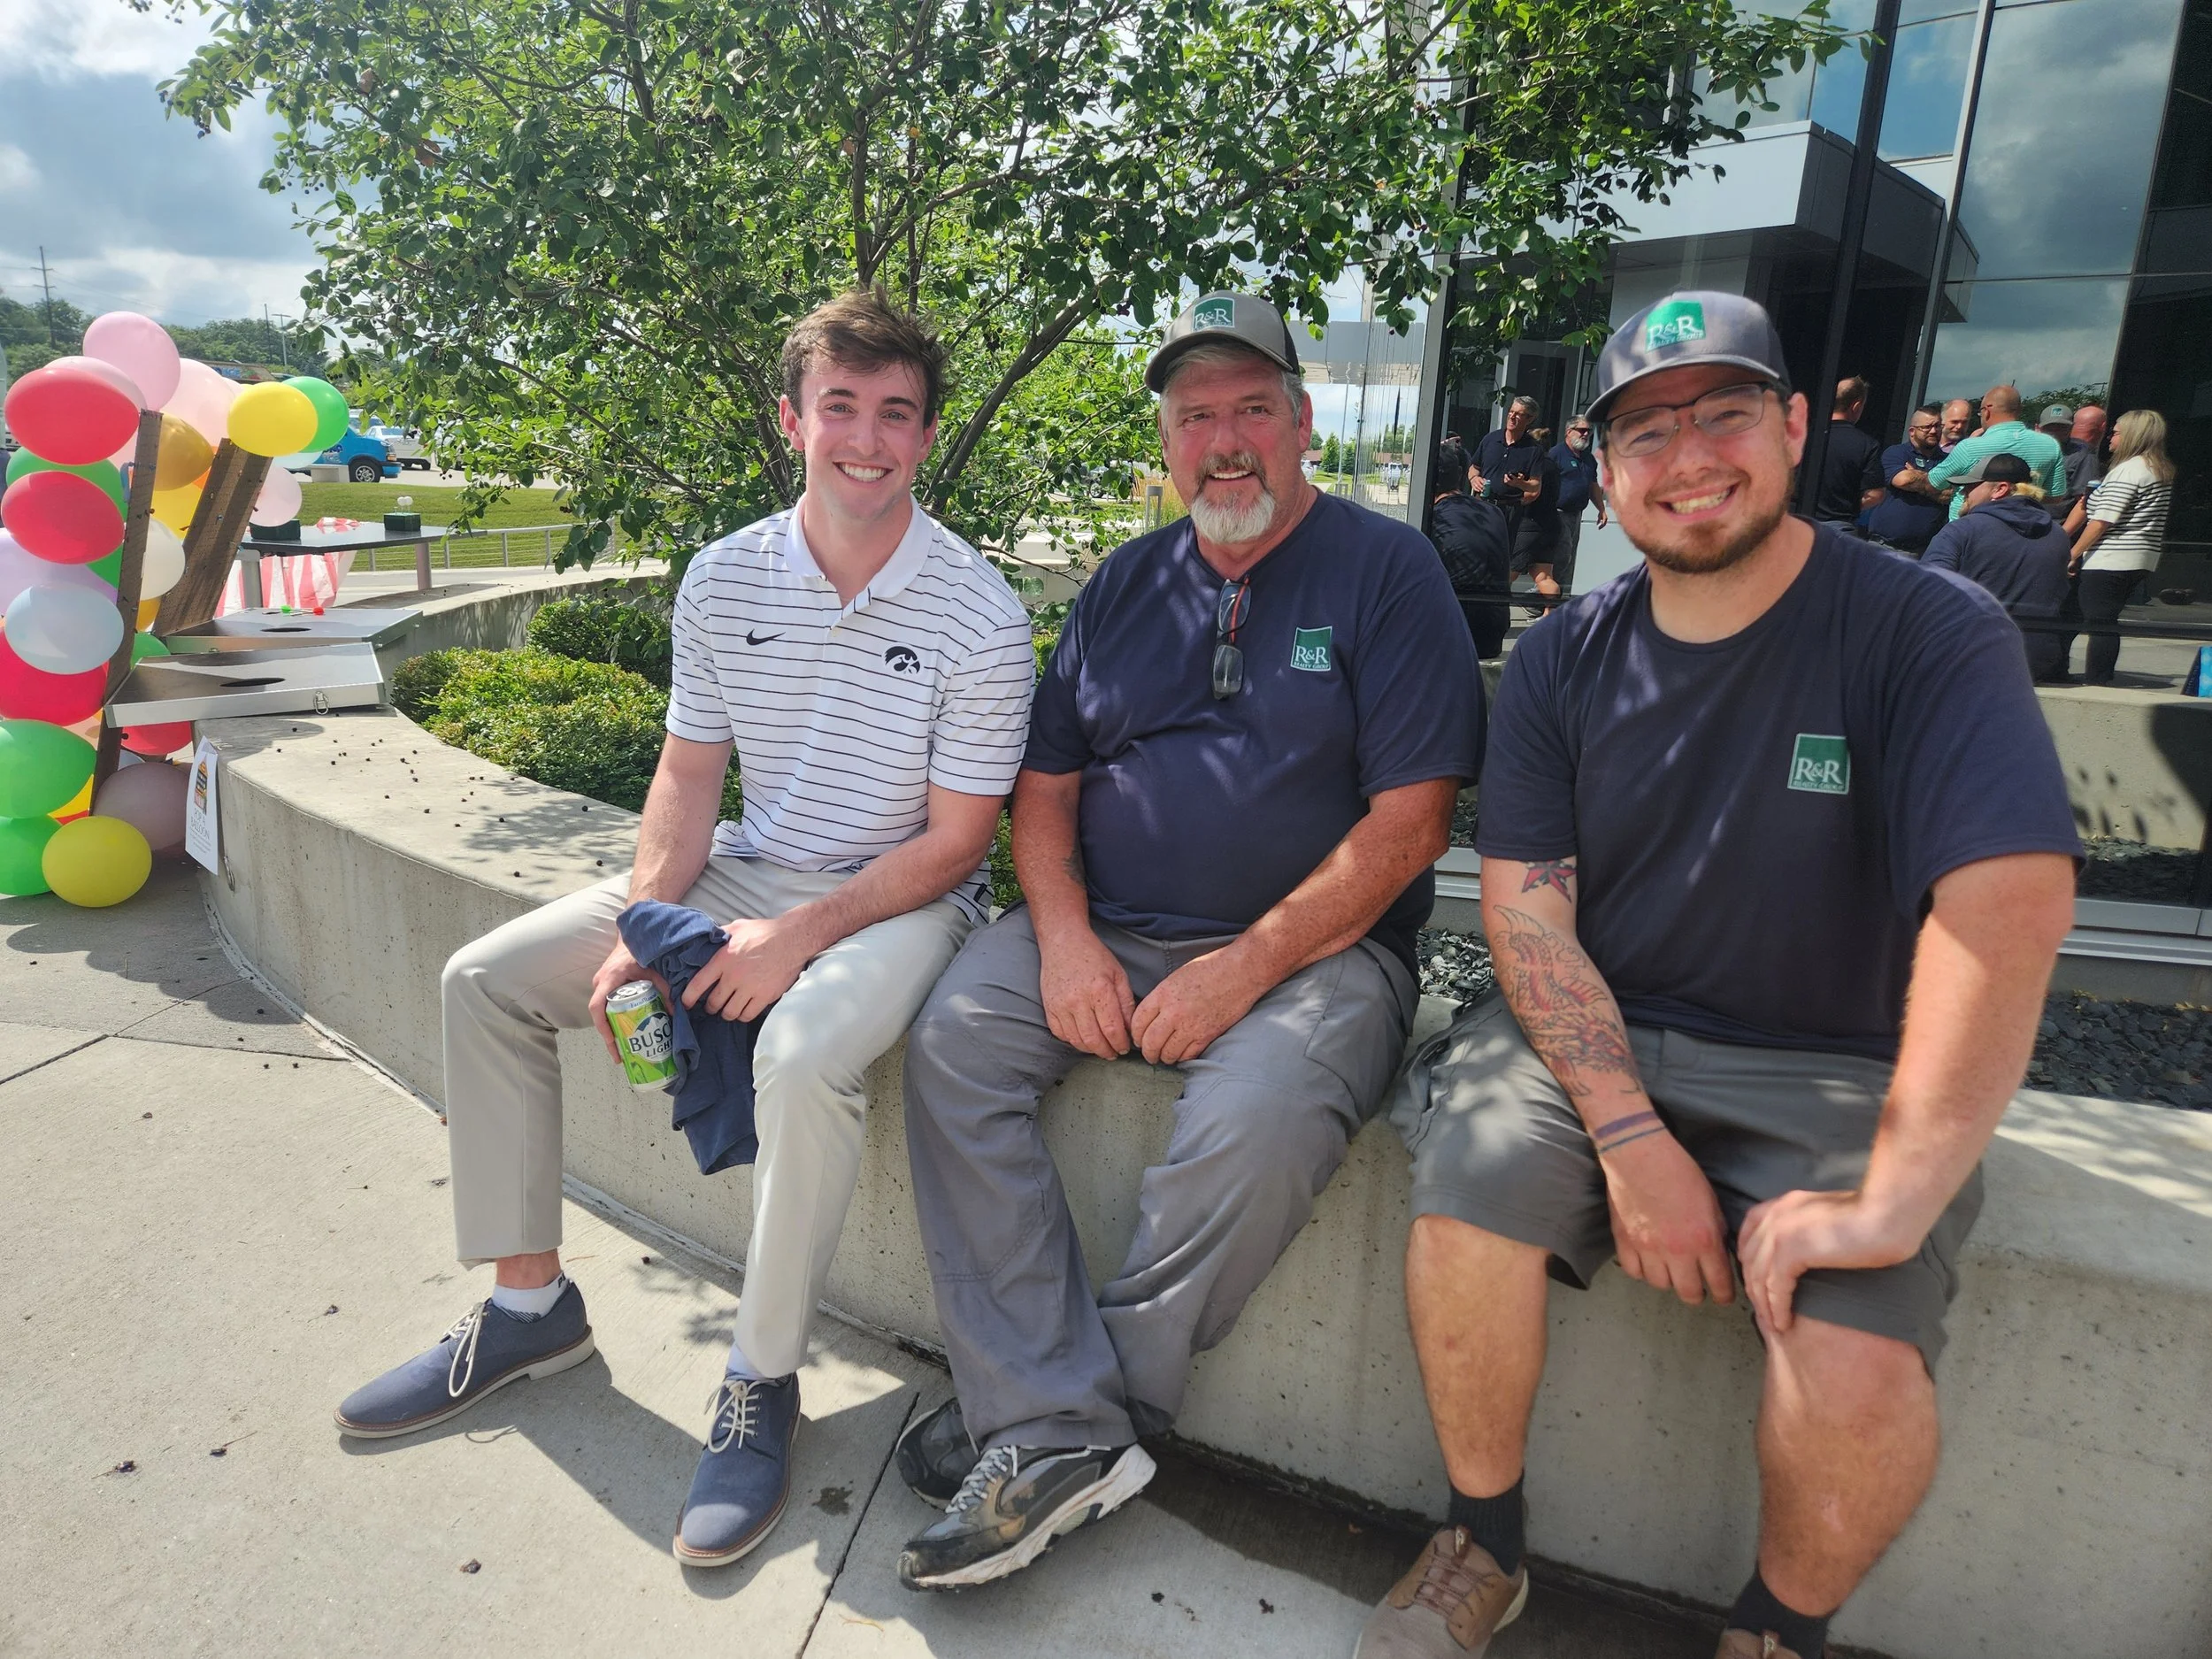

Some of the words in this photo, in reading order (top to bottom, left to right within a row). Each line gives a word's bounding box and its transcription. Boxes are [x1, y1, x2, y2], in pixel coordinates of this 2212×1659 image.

[1194, 308, 1232, 328] R&R
[1647, 316, 1703, 349] R&R
[1294, 644, 1329, 664] R&R
[1794, 757, 1844, 785] R&R
[628, 1022, 672, 1053] BUSC
[646, 1040, 672, 1057] LIGH
